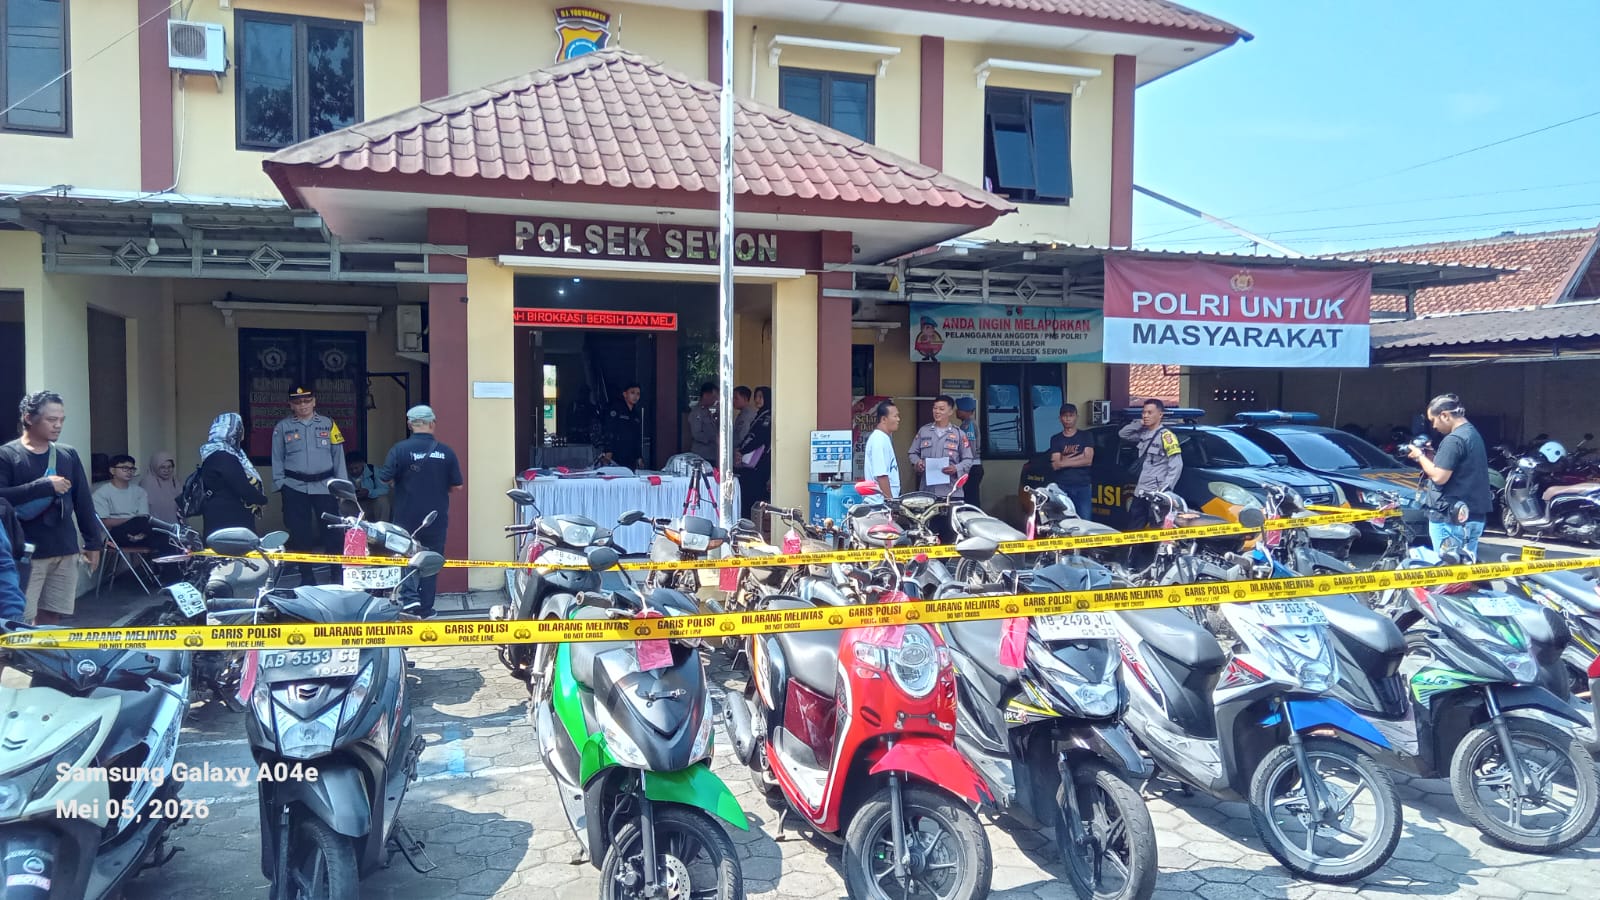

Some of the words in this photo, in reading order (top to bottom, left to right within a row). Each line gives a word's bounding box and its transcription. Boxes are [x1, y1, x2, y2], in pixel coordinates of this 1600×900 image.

[515, 221, 651, 257] POLSEK
[1132, 291, 1229, 317] POLRI
[1240, 295, 1345, 320] UNTUK
[528, 313, 582, 323] BIROKRASI
[586, 314, 624, 324] BERSIH
[626, 315, 648, 325] DAN
[943, 317, 975, 330] ANDA
[979, 317, 1011, 331] INGIN
[1015, 319, 1091, 332] MELAPORKAN
[945, 331, 1002, 339] PELANGGARAN
[1004, 332, 1039, 340] ANGGOTA
[1132, 323, 1344, 348] MASYARAKAT
[1063, 444, 1081, 454] NIKE
[1250, 583, 1282, 593] DILARANG
[1283, 579, 1315, 590] MELINTAS
[1333, 577, 1353, 586] GARIS
[1355, 575, 1376, 585] POLISI
[1094, 591, 1128, 602] DILARANG
[1130, 589, 1164, 600] MELINTAS
[1184, 586, 1205, 596] GARIS
[1207, 585, 1230, 595] POLISI
[925, 602, 963, 613] DILARANG
[964, 599, 1000, 610] MELINTAS
[1023, 597, 1046, 607] GARIS
[1048, 595, 1072, 605] POLISI
[849, 608, 873, 617] GARIS
[876, 605, 901, 616] POLISI
[657, 619, 684, 629] GARIS
[687, 617, 715, 628] POLISI
[741, 614, 782, 624] DILARANG
[784, 611, 824, 621] MELINTAS
[1060, 615, 1091, 626] 2498
[211, 628, 243, 639] GARIS
[247, 627, 281, 639] POLISI
[314, 626, 363, 637] DILARANG
[366, 625, 413, 636] MELINTAS
[444, 625, 474, 635] GARIS
[478, 624, 509, 634] POLISI
[538, 622, 583, 632] DILARANG
[585, 622, 630, 631] MELINTAS
[68, 631, 121, 642] DILARANG
[125, 629, 177, 641] MELINTAS
[341, 638, 350, 646] DO
[351, 638, 364, 646] NOT
[365, 637, 386, 645] CROSS
[481, 634, 494, 642] LINE
[226, 640, 249, 648] POLICE
[264, 653, 285, 669] AB
[292, 649, 332, 666] 5553
